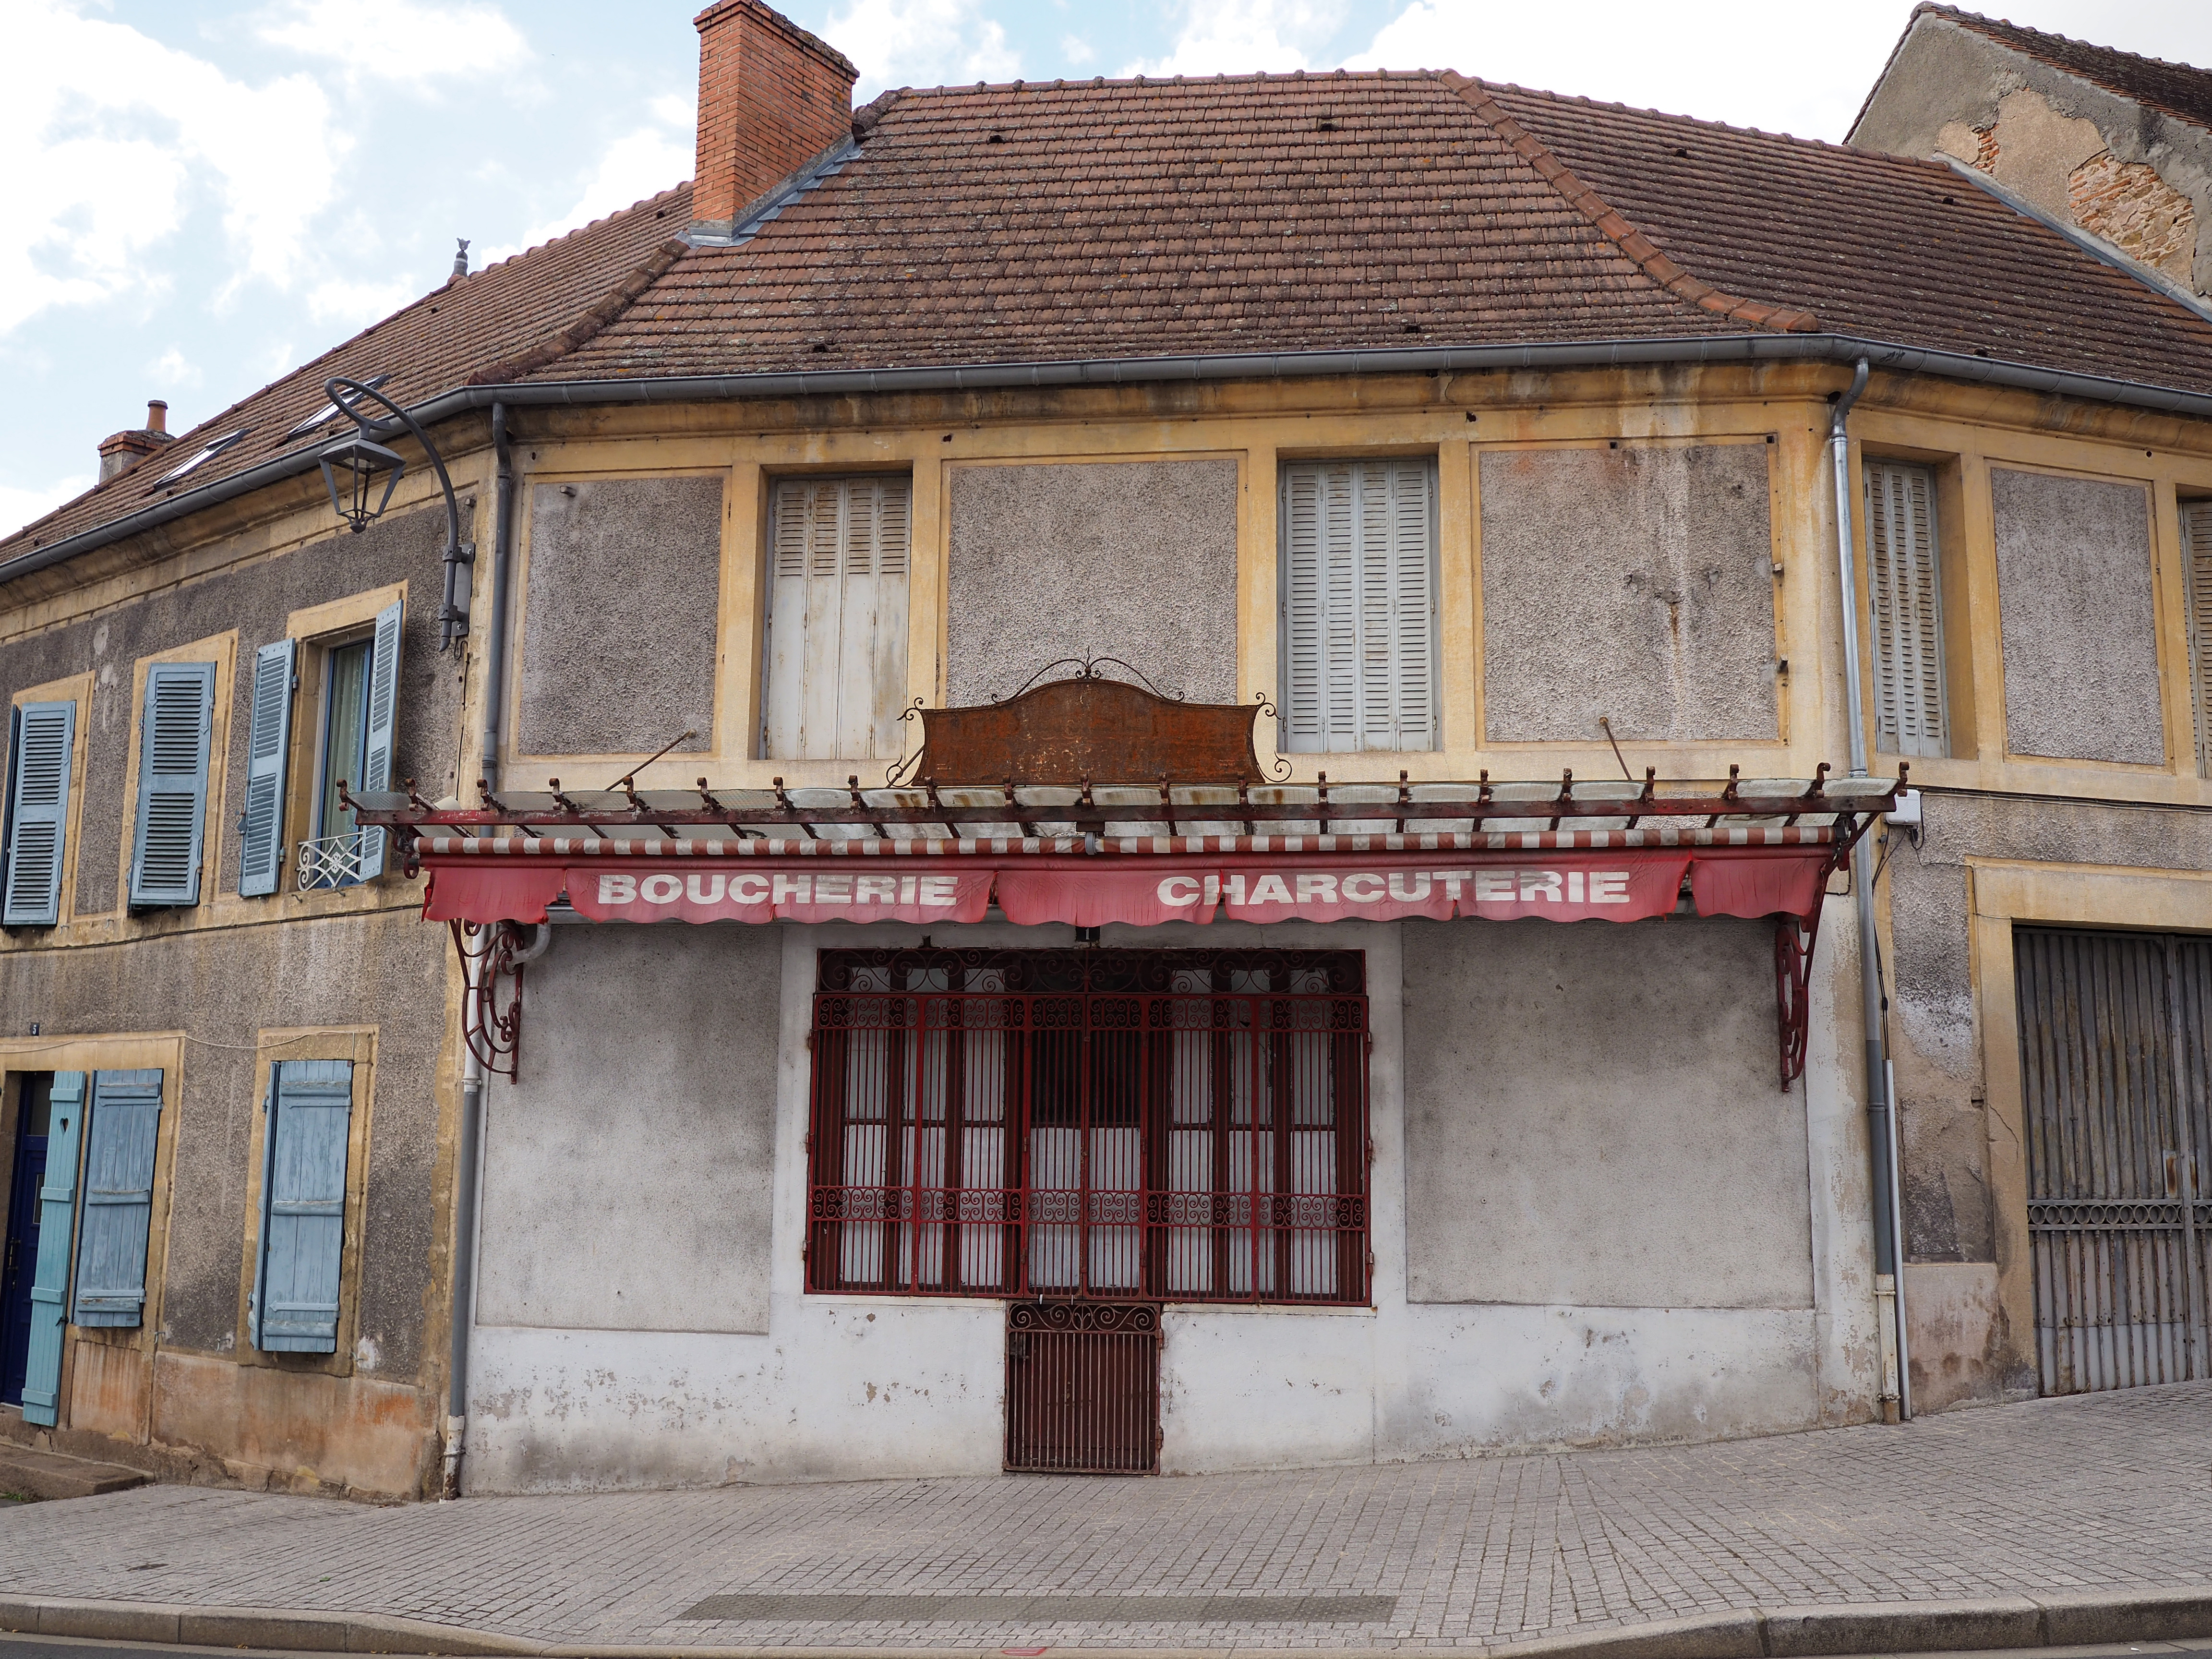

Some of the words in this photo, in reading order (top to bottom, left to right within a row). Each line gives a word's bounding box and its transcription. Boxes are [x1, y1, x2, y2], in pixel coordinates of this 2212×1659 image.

[598, 874, 958, 905] BOUCHERIE
[1156, 870, 1630, 905] CHARCUTERIE
[1085, 927, 1090, 940] 1
[33, 1024, 36, 1035] 5
